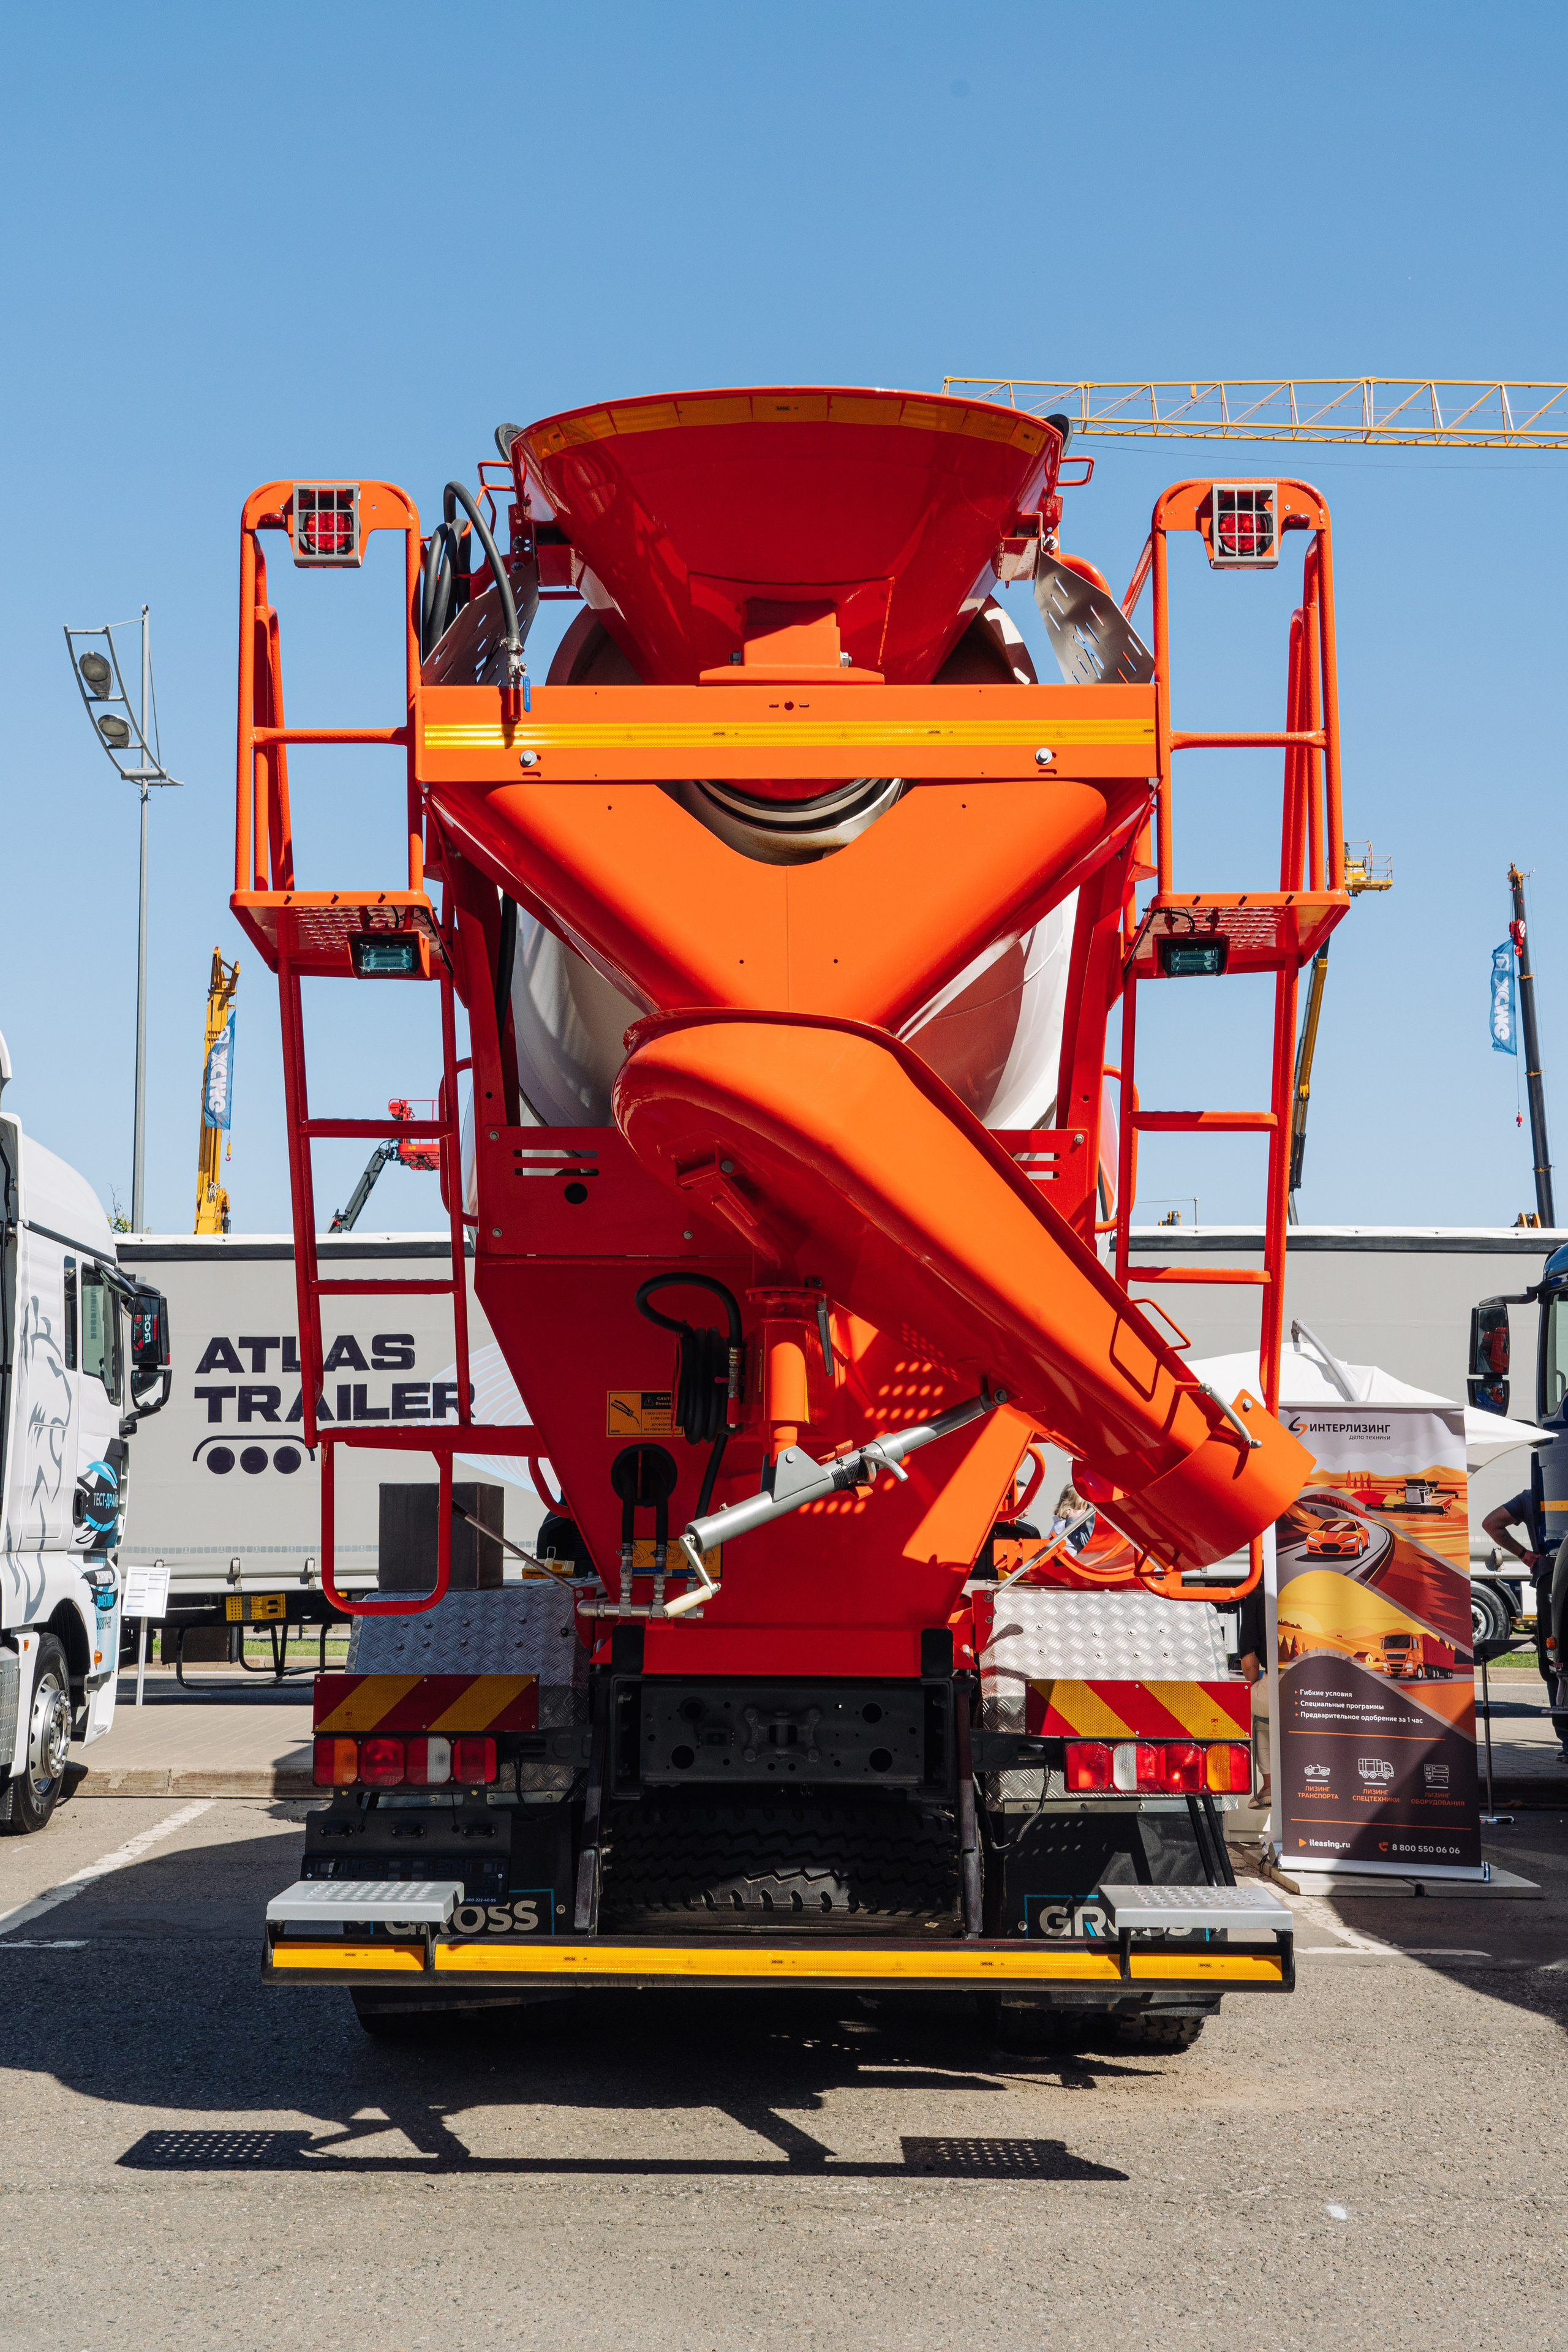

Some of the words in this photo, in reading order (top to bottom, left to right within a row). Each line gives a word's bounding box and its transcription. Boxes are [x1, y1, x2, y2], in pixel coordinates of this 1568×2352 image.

[1494, 977, 1510, 1040] XCMG
[208, 1050, 228, 1113] XCMG
[195, 1333, 415, 1374] ATLAS
[194, 1382, 476, 1423] TRAILER
[1310, 1423, 1391, 1433] ИНТЕРЛИЗИНГ
[93, 1491, 119, 1509] ТЕСТ-ДРАЙВ
[1300, 1711, 1360, 1720] Предварительное
[1309, 1839, 1351, 1849] ileasing.ru
